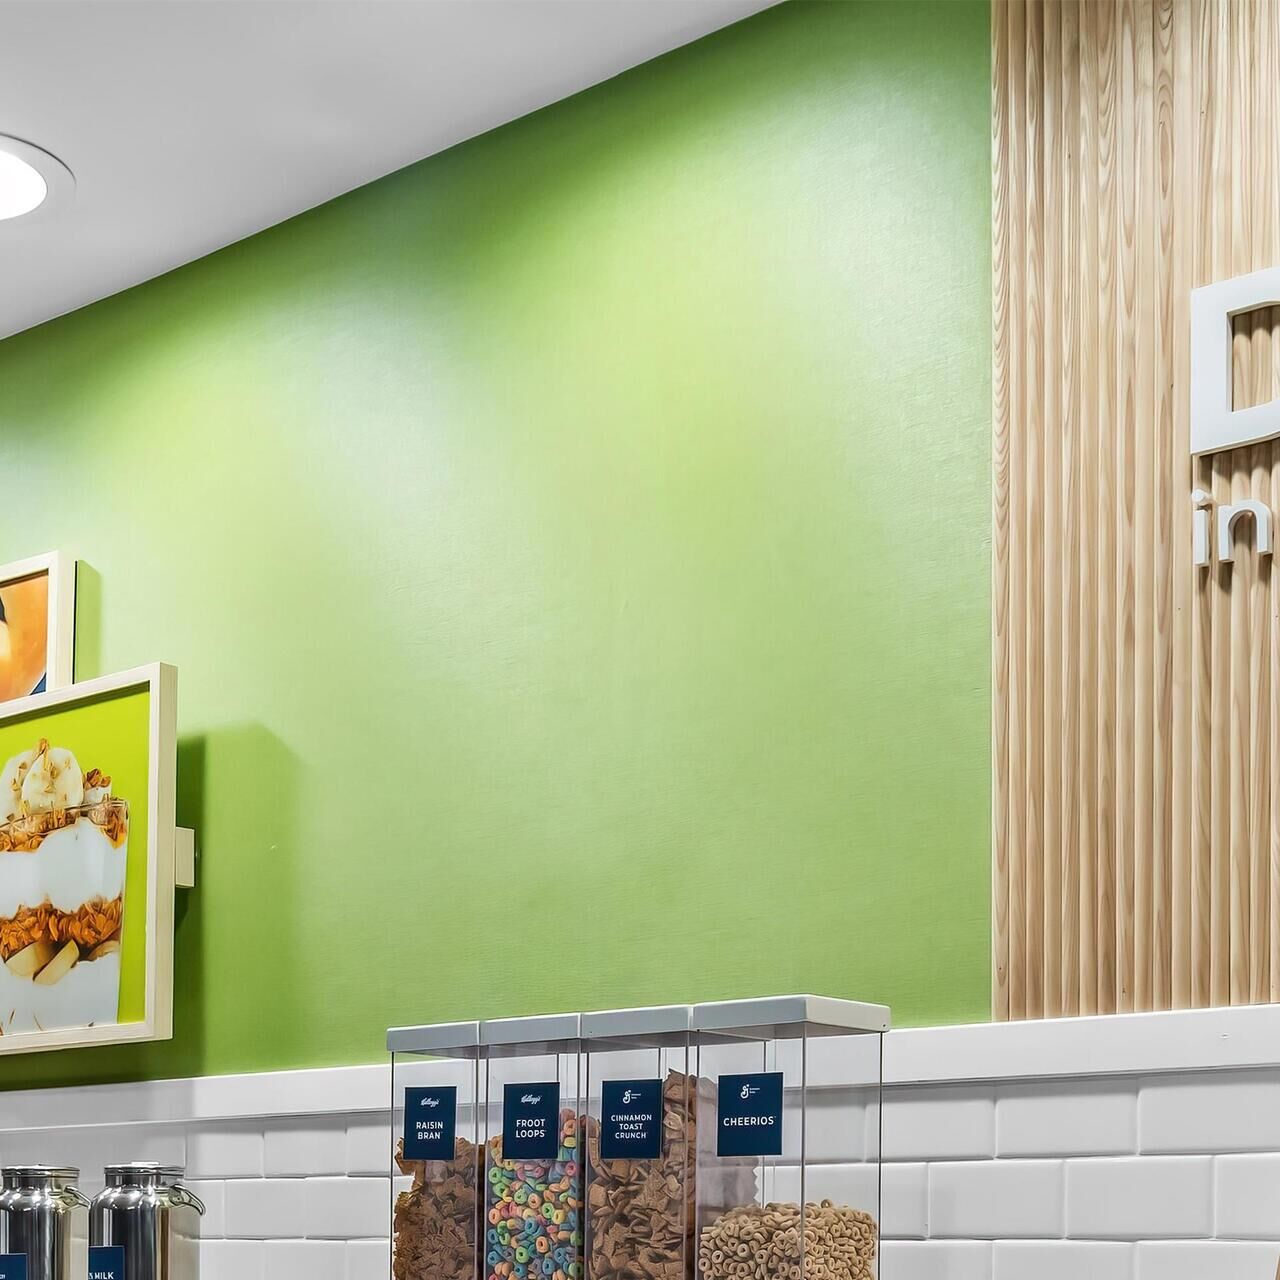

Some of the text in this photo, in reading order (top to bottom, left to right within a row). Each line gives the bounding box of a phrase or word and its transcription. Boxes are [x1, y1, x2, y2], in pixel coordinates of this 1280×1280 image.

[1190, 488, 1273, 568] in
[610, 1114, 652, 1122] CINNAMON
[723, 1116, 775, 1126] CHEERIOS
[416, 1121, 444, 1130] RAISIN
[516, 1119, 546, 1128] FROOT
[417, 1131, 442, 1140] BRAN
[516, 1130, 546, 1138] LOOPS
[94, 1271, 114, 1280] MILK
